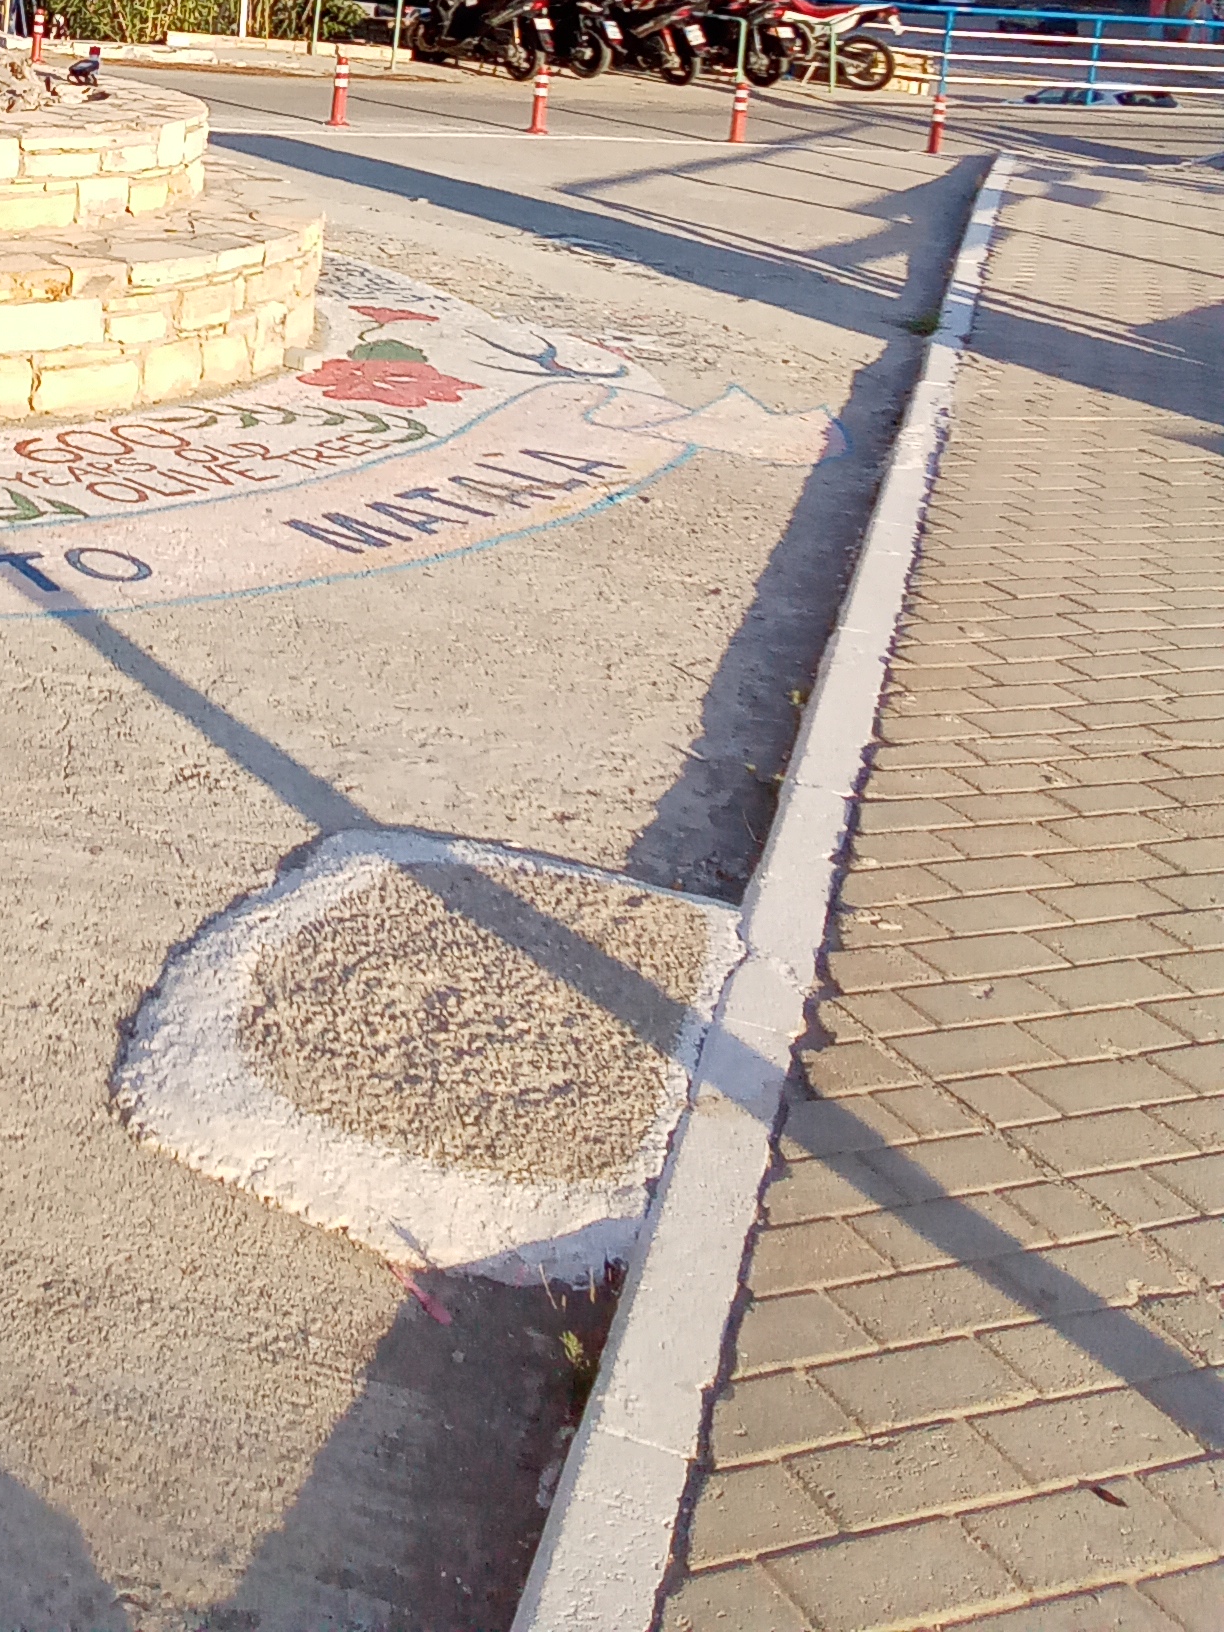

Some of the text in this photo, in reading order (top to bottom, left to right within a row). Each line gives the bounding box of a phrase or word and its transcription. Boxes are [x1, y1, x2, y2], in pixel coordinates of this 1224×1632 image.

[13, 424, 192, 464] 600
[86, 433, 391, 503] OLIVE TREE
[175, 441, 271, 464] OLD
[281, 448, 628, 555] MATALA
